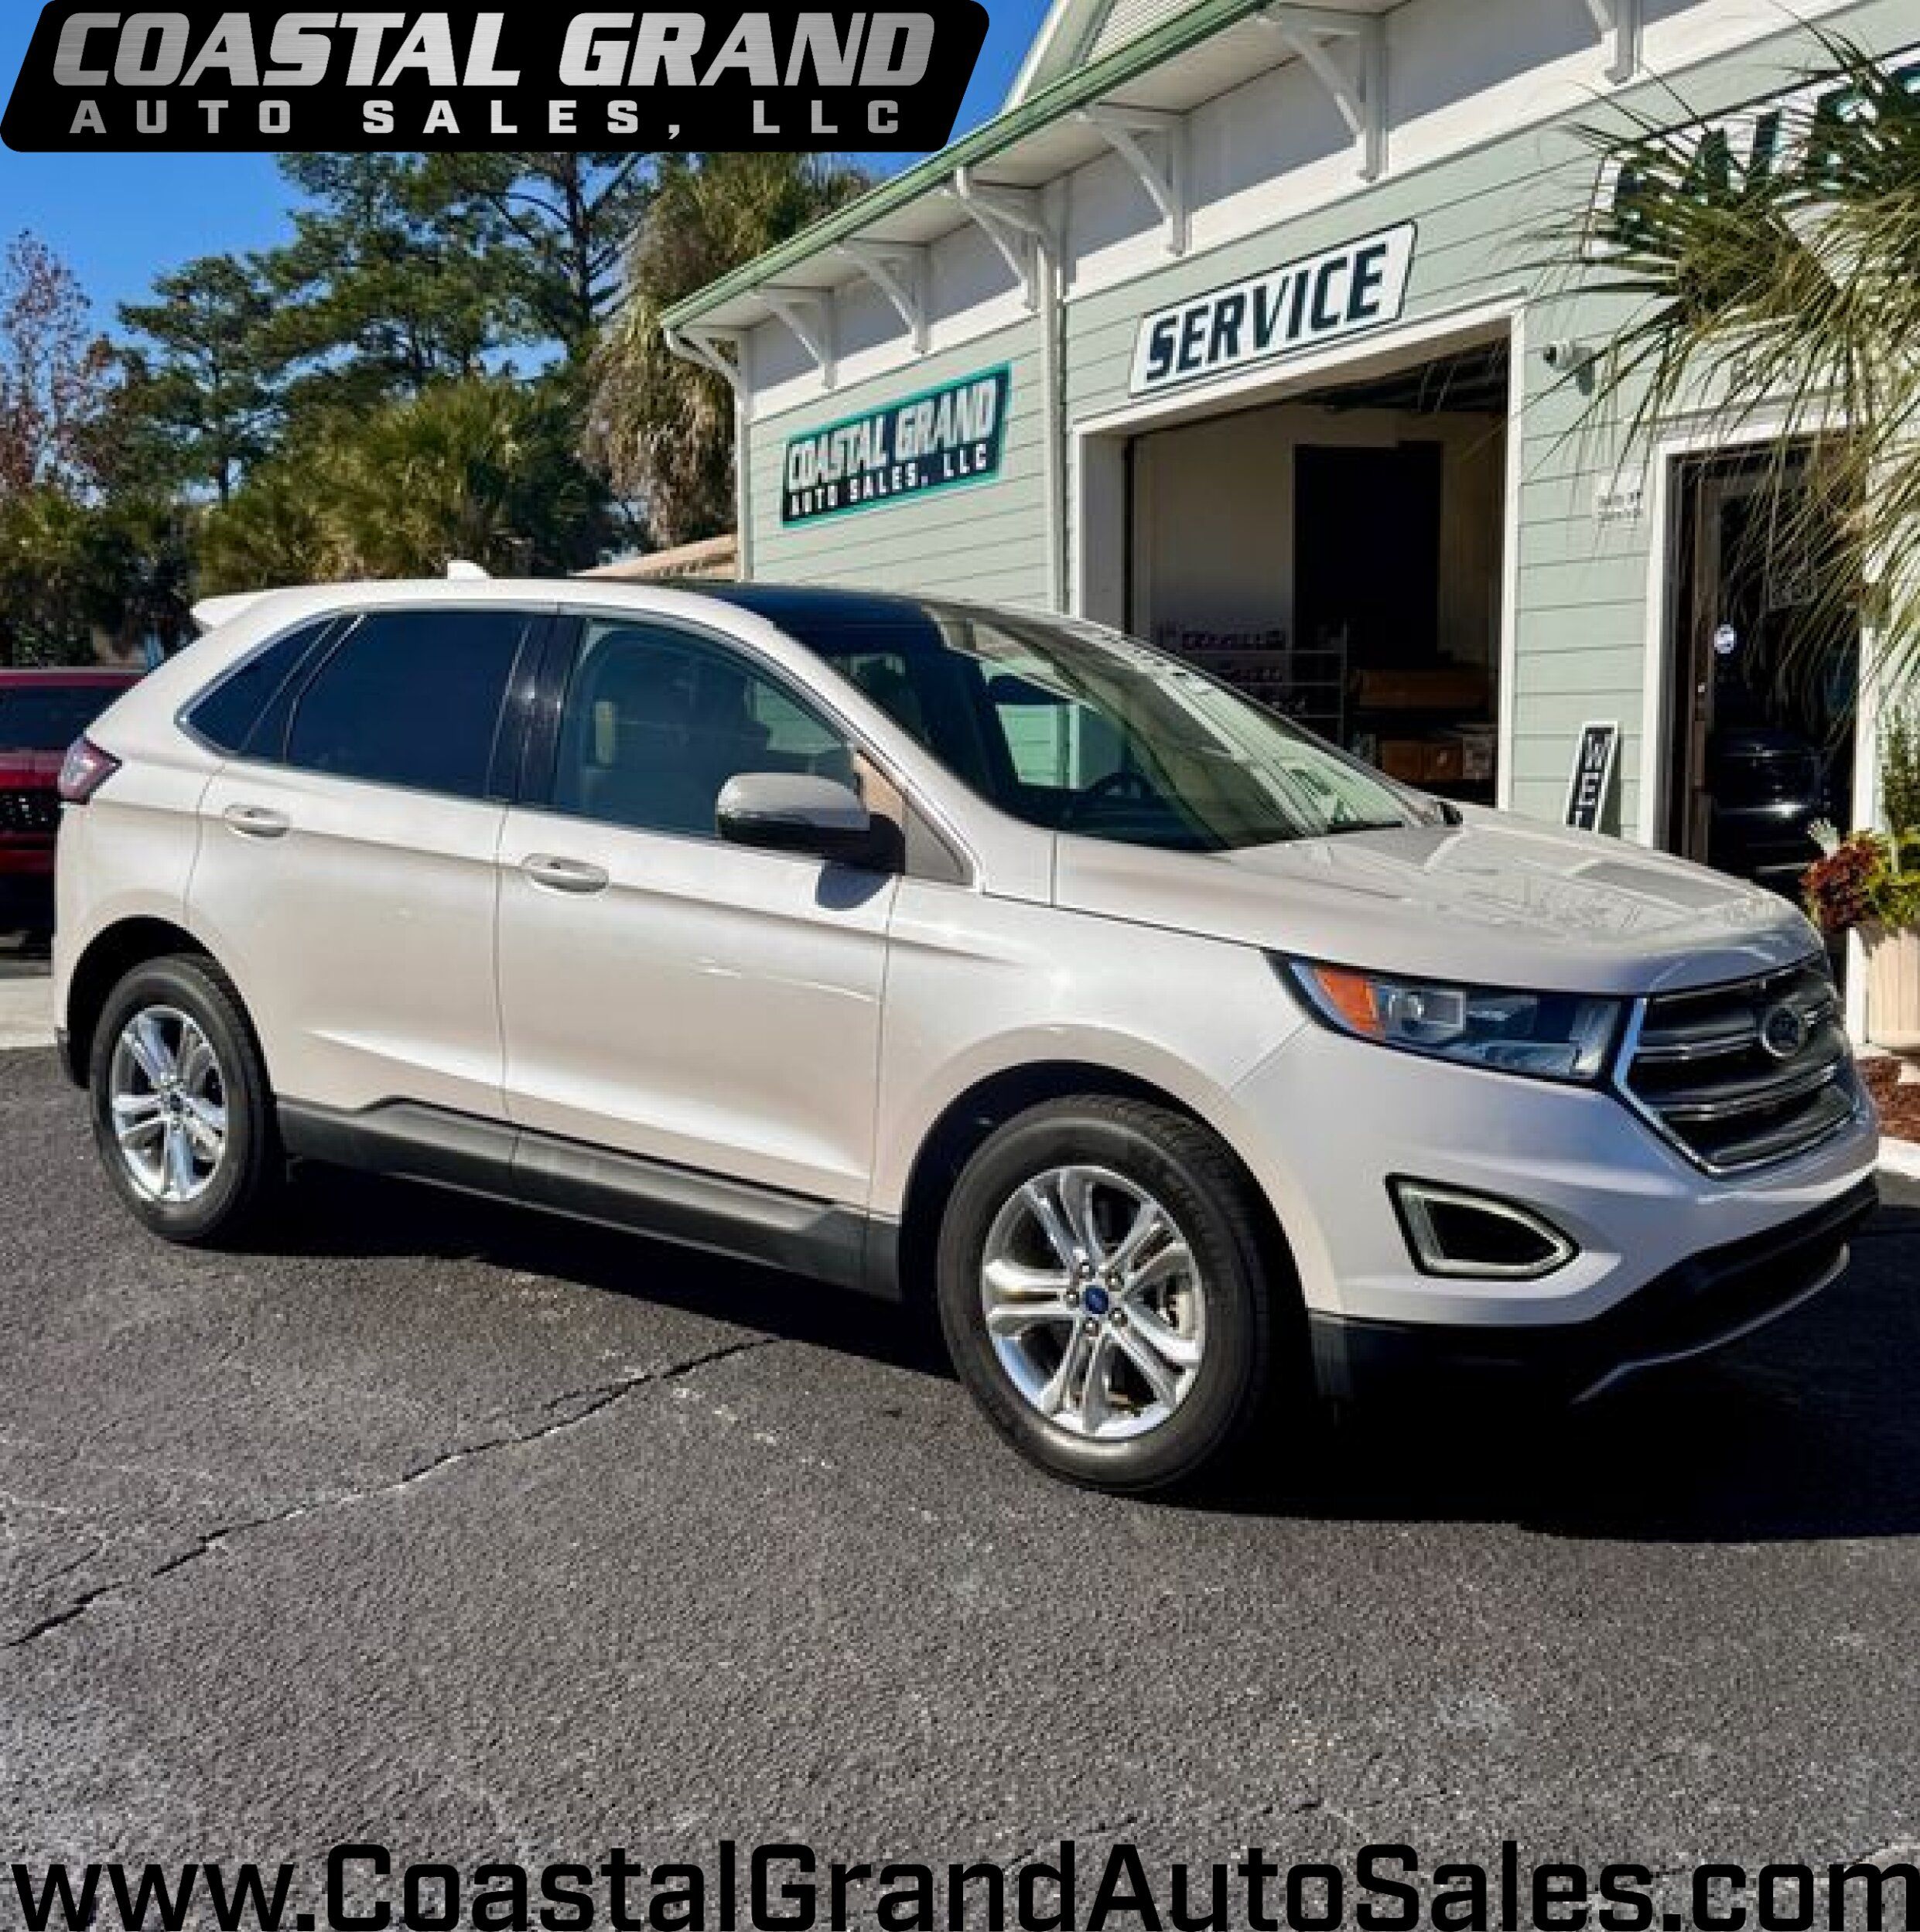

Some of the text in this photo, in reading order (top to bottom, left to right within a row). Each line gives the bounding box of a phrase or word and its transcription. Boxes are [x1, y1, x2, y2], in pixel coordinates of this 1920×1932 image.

[1146, 243, 1387, 381] SERVICE
[787, 378, 996, 493] COASTAL GRAND
[790, 484, 839, 515] AUTO
[943, 443, 987, 478] LLC
